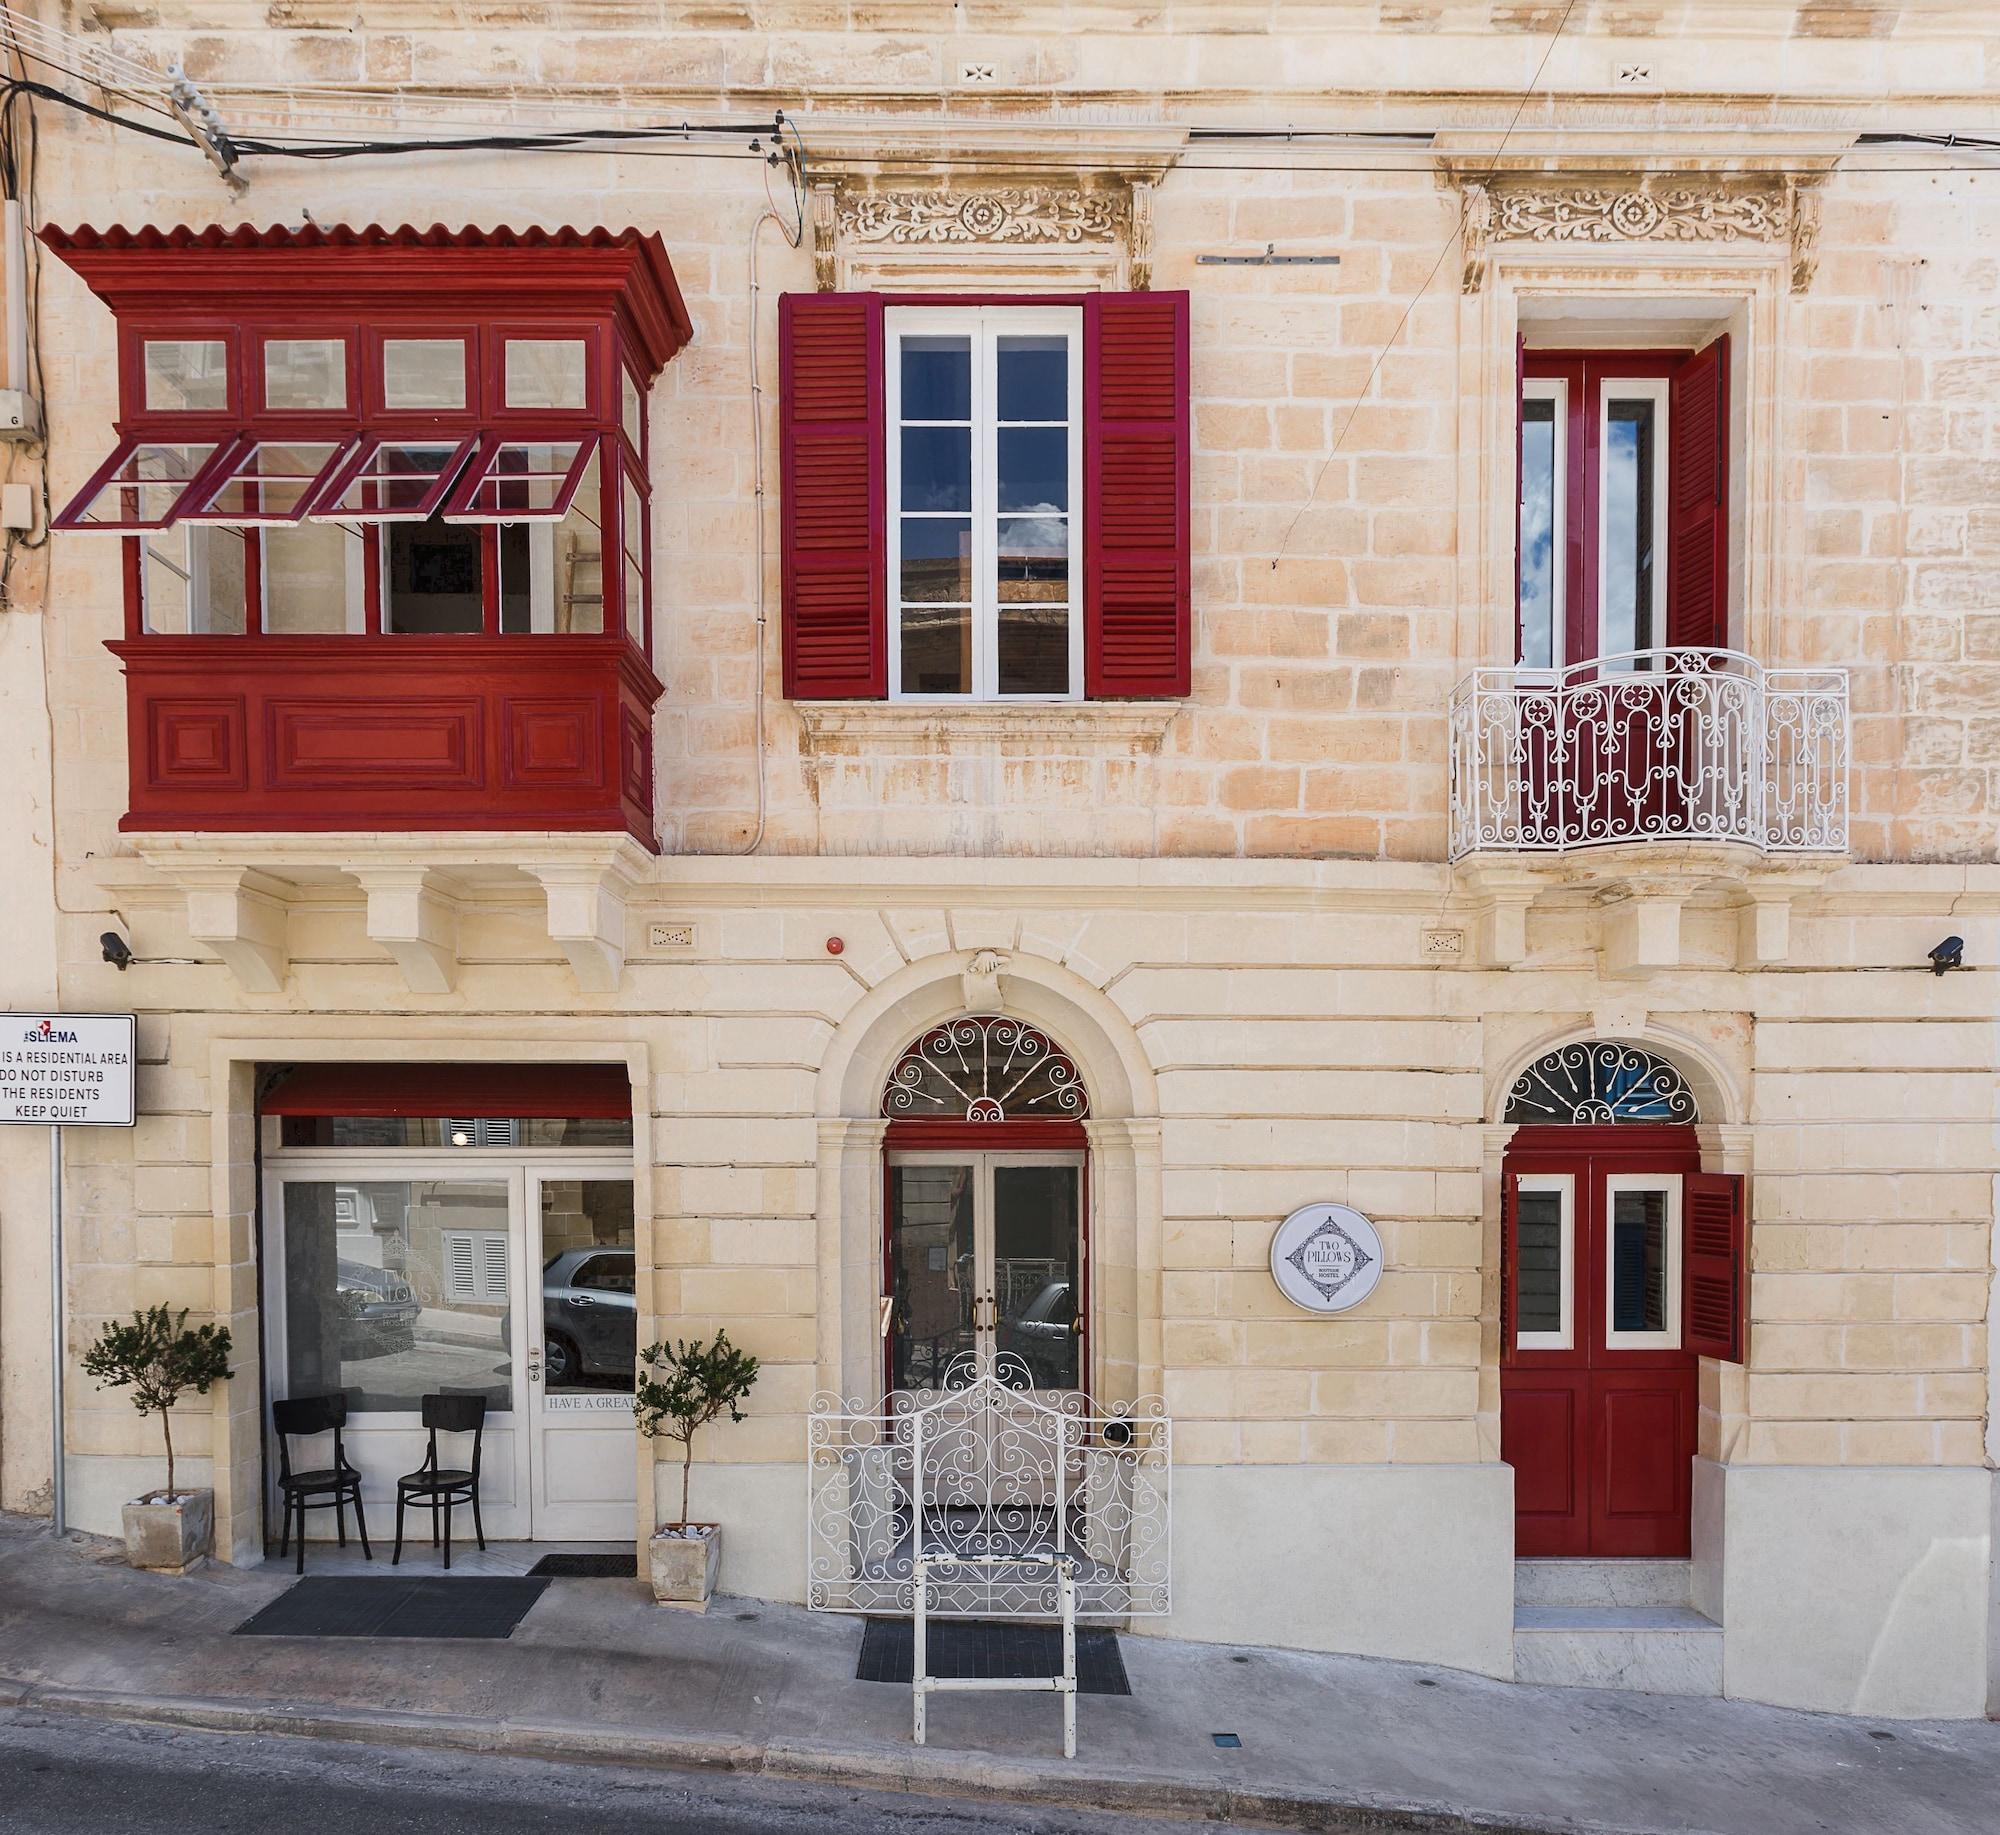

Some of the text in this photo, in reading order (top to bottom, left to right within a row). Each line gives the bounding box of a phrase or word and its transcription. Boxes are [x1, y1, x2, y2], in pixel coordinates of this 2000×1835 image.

[29, 1031, 78, 1043] SLIEMA
[2, 1052, 128, 1064] IS A RESIDENTIAL AREA
[0, 1070, 104, 1082] DO NOT DISTURB
[2, 1088, 100, 1100] THE RESIDENTS
[15, 1105, 87, 1118] KEEP QUIET
[1318, 1241, 1339, 1251] TWO
[1307, 1250, 1351, 1263] PILLOWS
[549, 1397, 635, 1409] HAVE A GREAT
